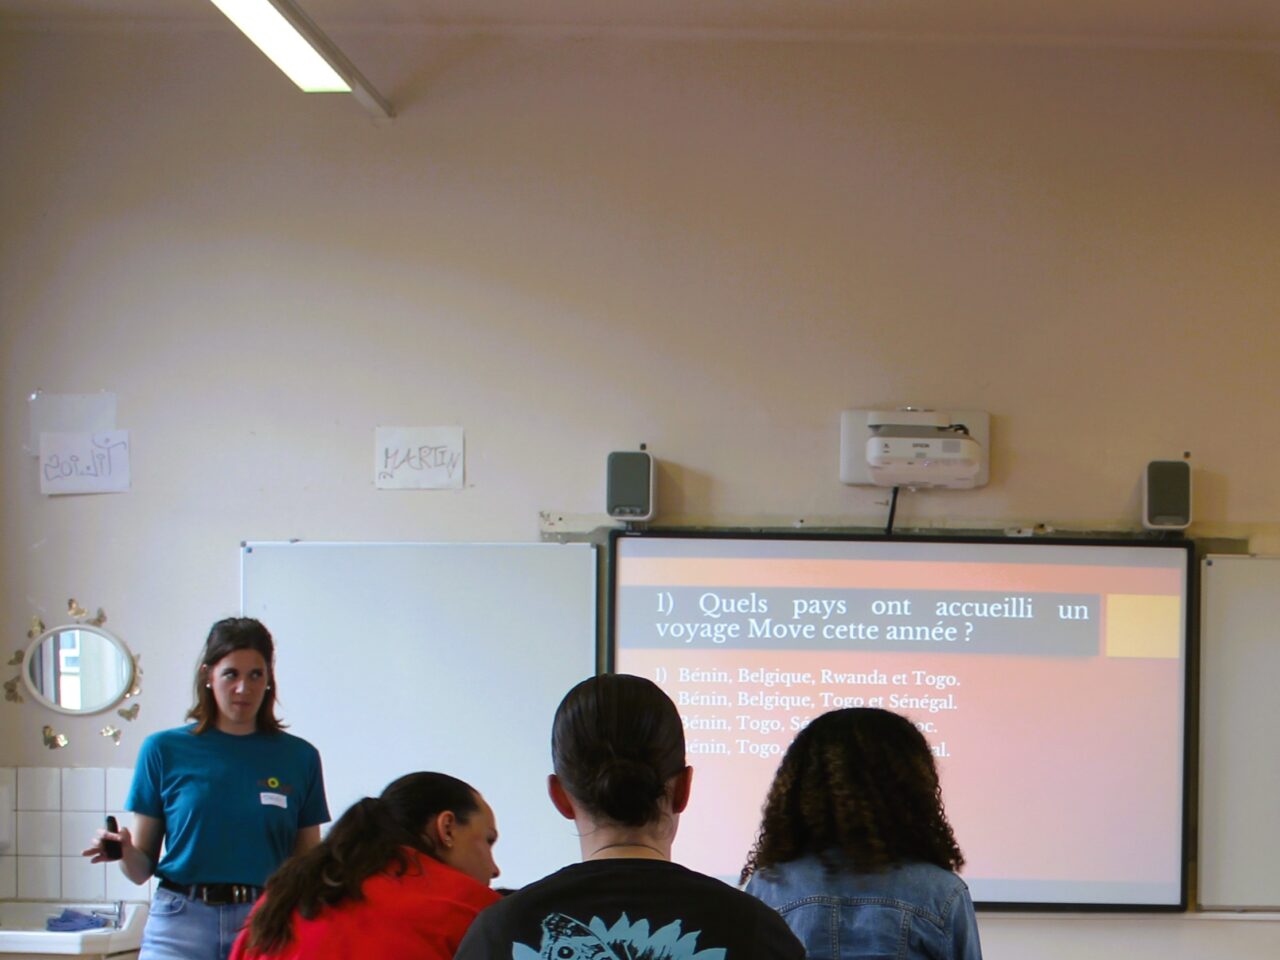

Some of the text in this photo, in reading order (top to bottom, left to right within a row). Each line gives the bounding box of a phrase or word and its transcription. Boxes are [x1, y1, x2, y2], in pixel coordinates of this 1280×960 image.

[699, 593, 768, 618] Quels
[792, 598, 847, 620] pays
[871, 599, 912, 616] ont
[936, 596, 1033, 619] accueilli
[1058, 603, 1090, 620] un
[656, 620, 974, 642] voyage Move cette année ?
[679, 668, 732, 686] Bénin,
[738, 668, 816, 687] Belgique,
[821, 670, 887, 686] Rwanda
[892, 672, 907, 686] et
[912, 671, 961, 688] Togo.
[679, 691, 958, 711] Bénin, Belgique, Togo et Sénégal.
[737, 715, 785, 734] Togo,
[685, 739, 731, 757] énin,
